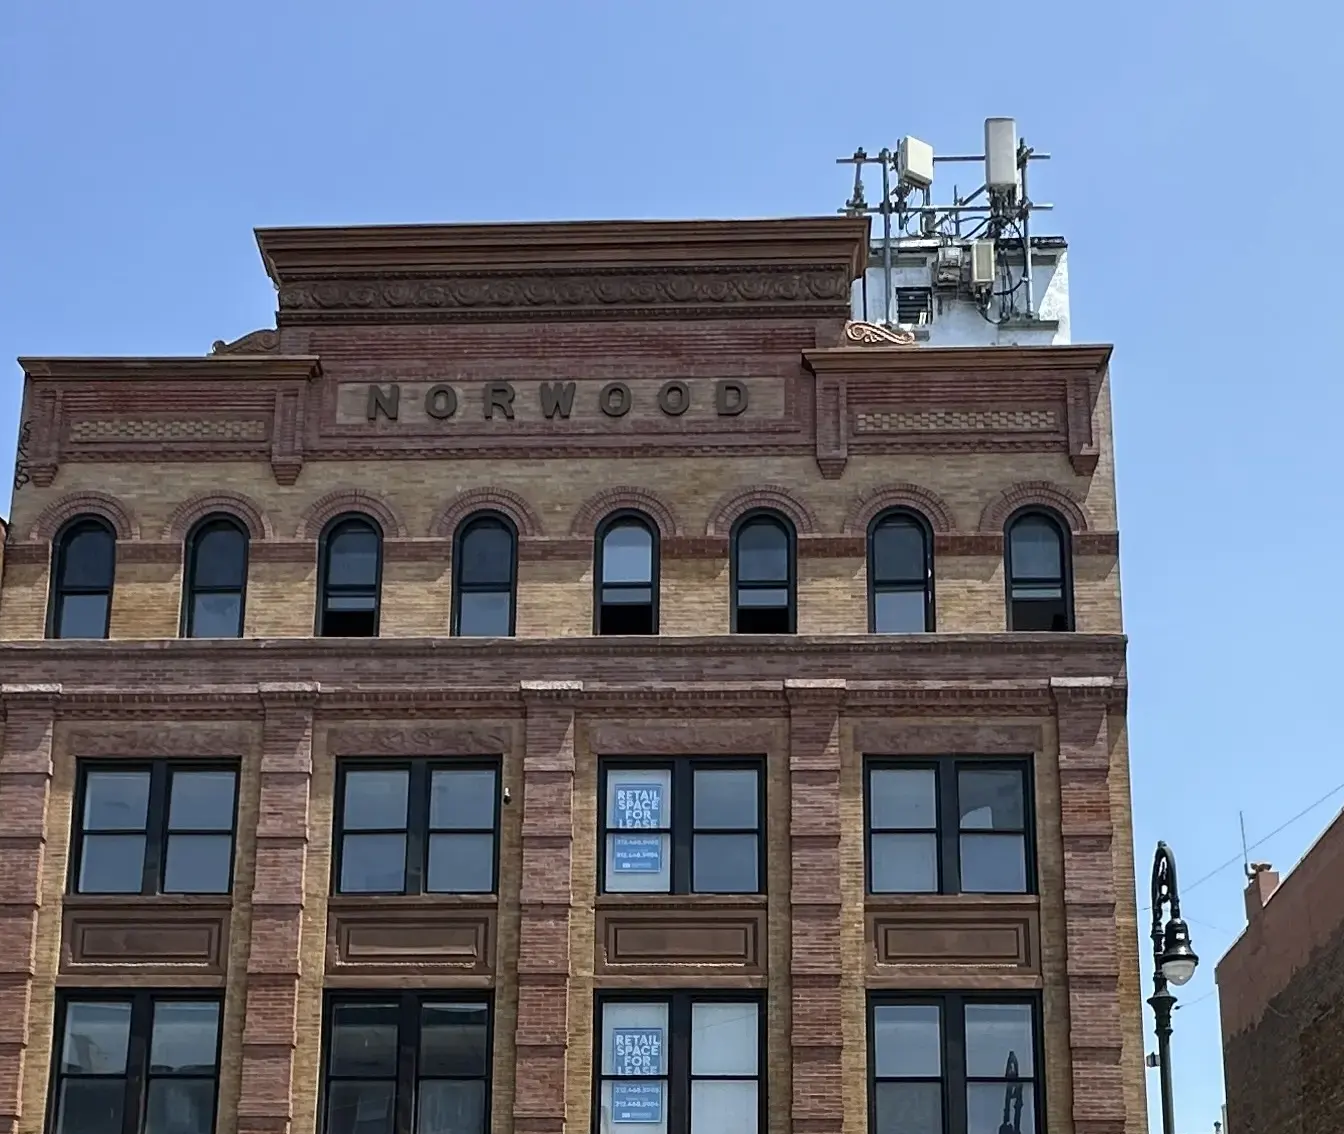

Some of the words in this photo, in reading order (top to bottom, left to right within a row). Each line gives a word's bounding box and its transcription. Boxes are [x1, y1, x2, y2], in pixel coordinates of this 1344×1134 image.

[367, 380, 749, 421] NORWOOD
[617, 790, 660, 801] RETAIL
[618, 800, 659, 810] SPACE
[625, 810, 651, 820] FOR
[616, 1034, 661, 1046] RETAIL
[616, 1045, 659, 1056] SPACE
[624, 1055, 651, 1066] FOR
